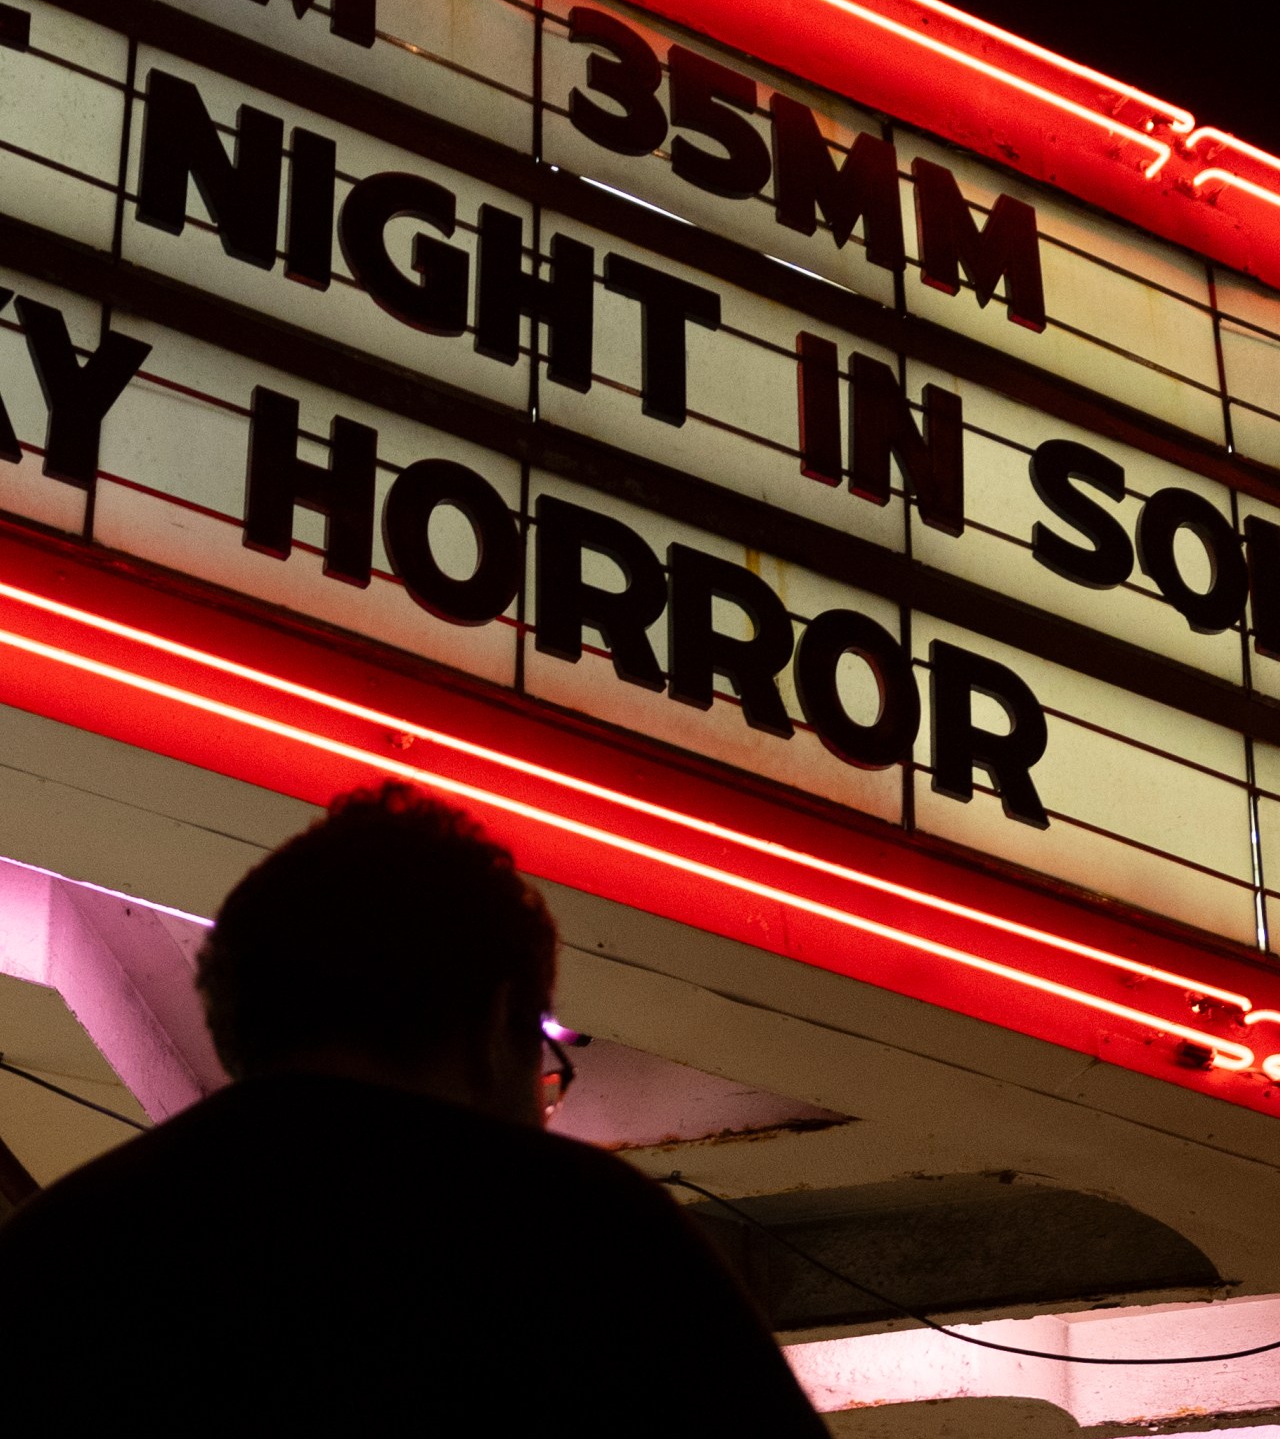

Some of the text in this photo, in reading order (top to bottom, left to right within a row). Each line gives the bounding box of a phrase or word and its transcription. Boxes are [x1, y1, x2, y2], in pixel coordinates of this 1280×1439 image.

[136, 66, 721, 428] NIGHT
[796, 330, 965, 538] IN
[567, 4, 1047, 334] 35MM
[241, 384, 1050, 830] HORROR
